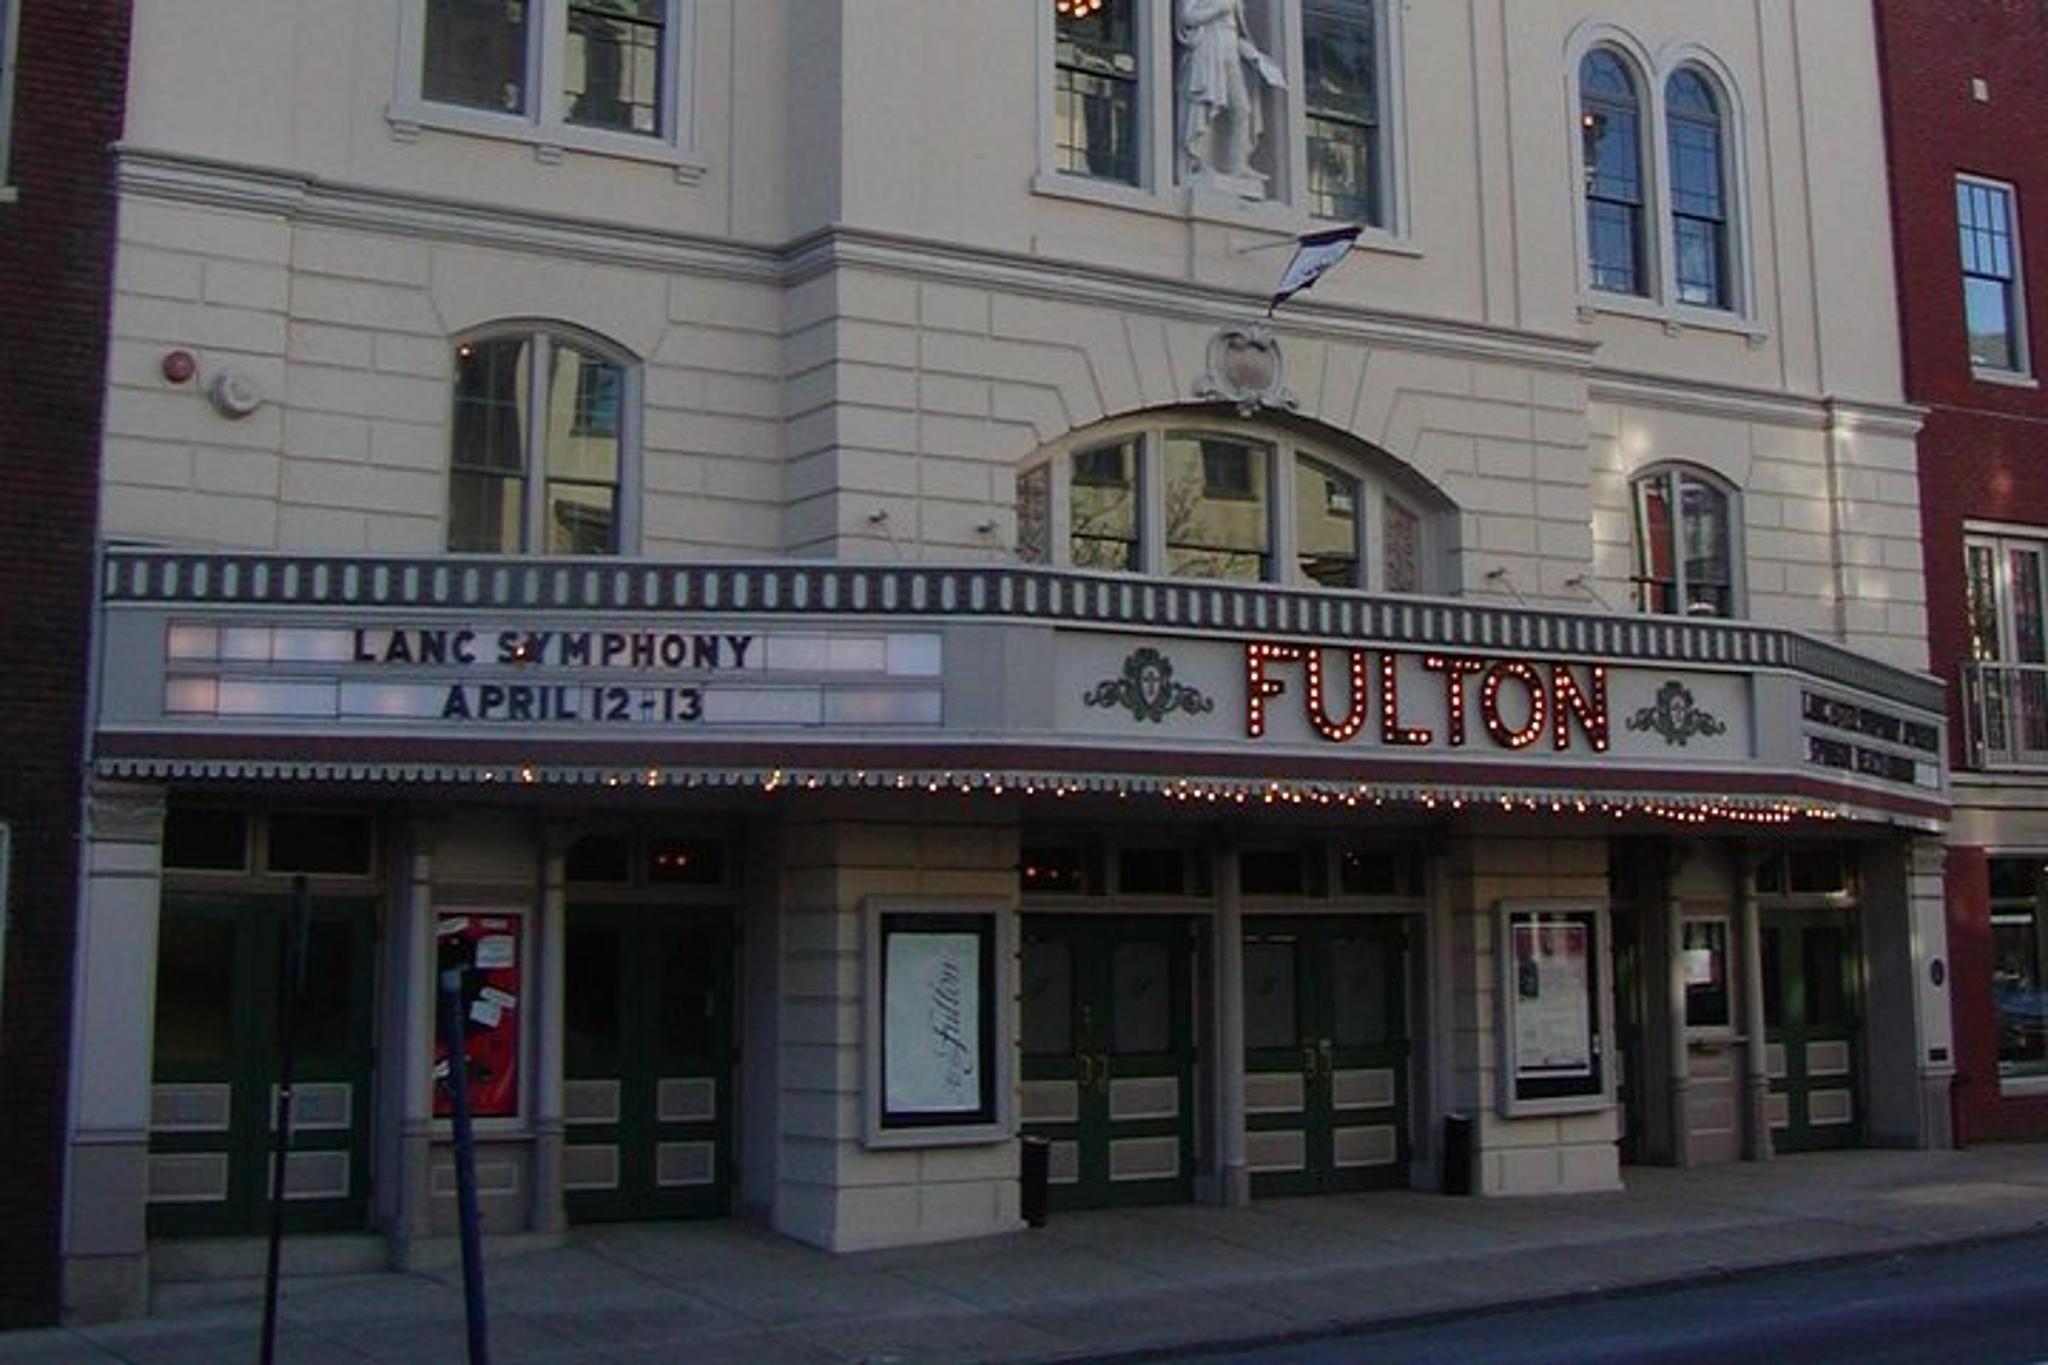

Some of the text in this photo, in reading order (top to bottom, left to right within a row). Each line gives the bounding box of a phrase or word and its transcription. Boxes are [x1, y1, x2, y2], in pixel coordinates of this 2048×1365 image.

[354, 628, 752, 669] LANC SYMPHONY
[441, 683, 703, 722] APRIL 12-13
[1247, 640, 1608, 752] FULTON
